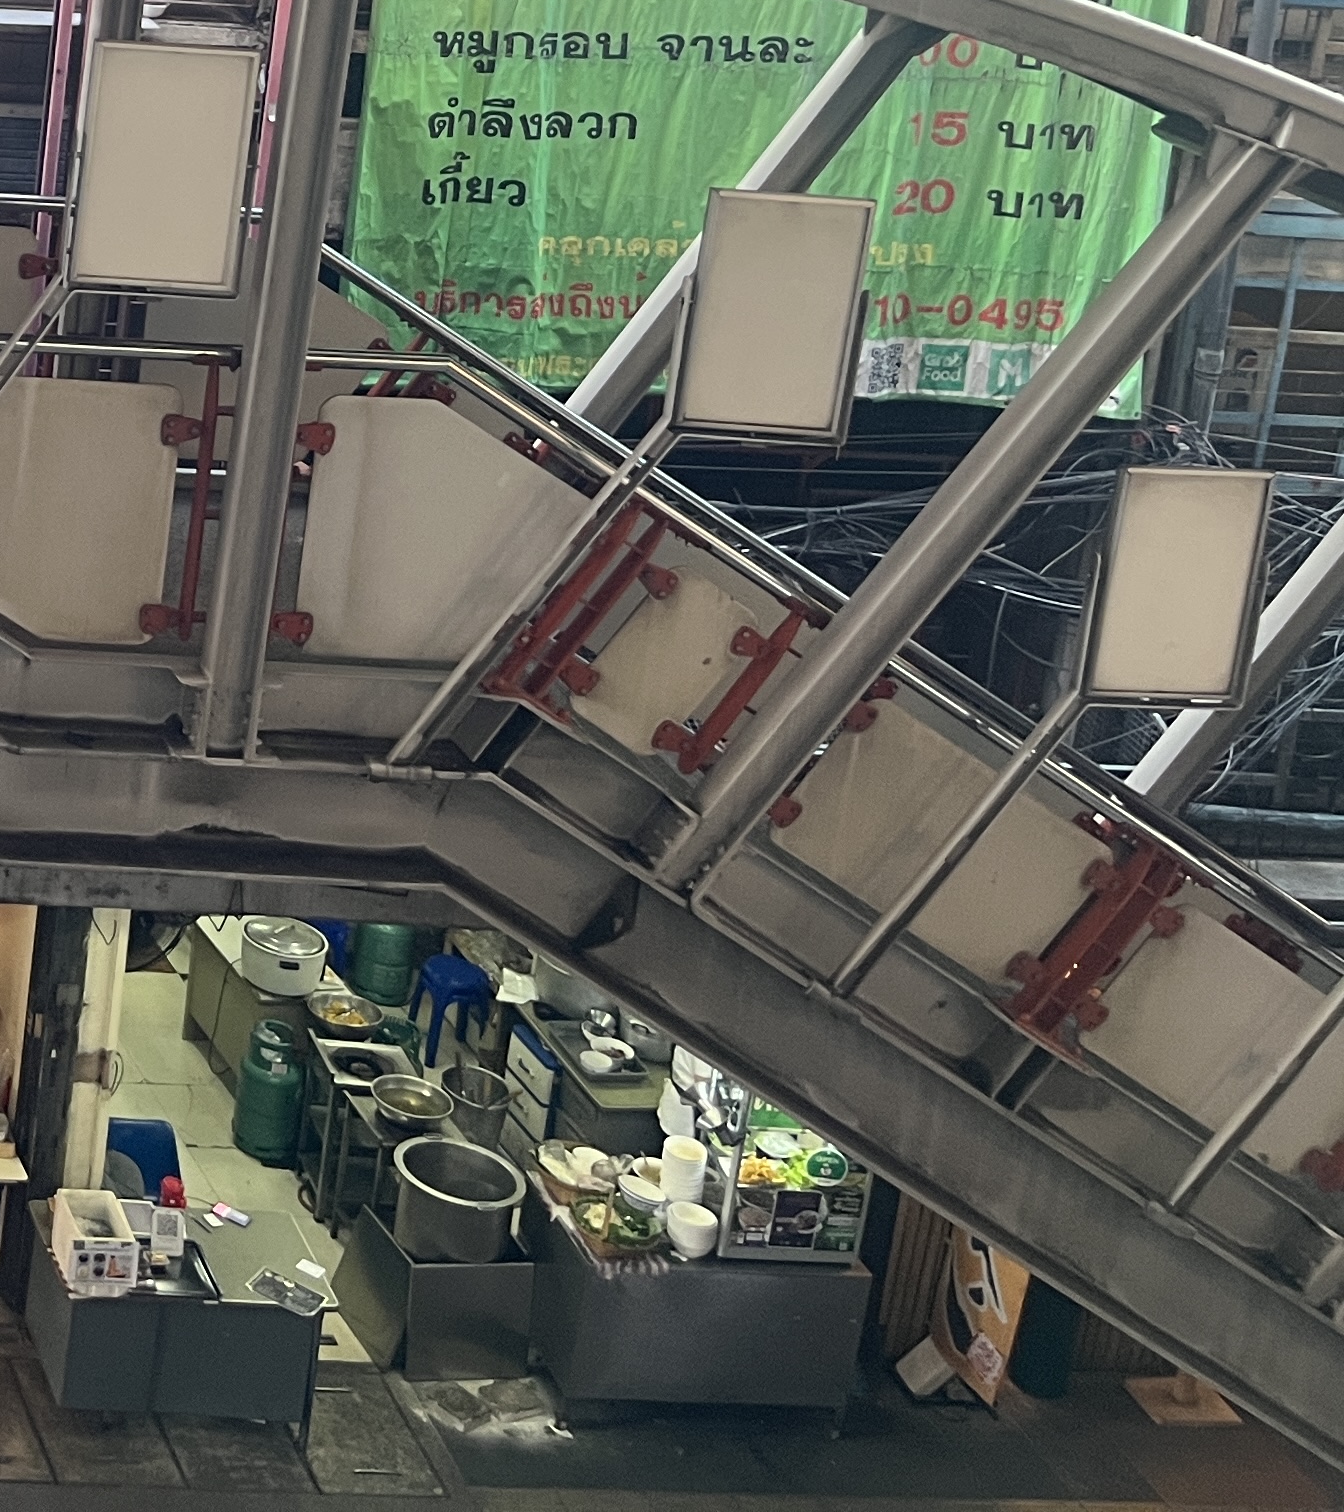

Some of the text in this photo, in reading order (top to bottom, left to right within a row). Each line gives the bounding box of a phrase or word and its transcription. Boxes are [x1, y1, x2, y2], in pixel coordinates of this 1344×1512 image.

[433, 30, 629, 74] หมูกรอบ
[656, 34, 814, 64] จานละ
[428, 97, 1096, 152] ตำลึงลวก 15 บาท
[892, 178, 956, 216] 20
[986, 188, 1085, 220] บาท
[415, 272, 1065, 332] บริการส่งถึงบ้ 10-0495
[922, 368, 961, 382] Food
[925, 352, 963, 367] Grab
